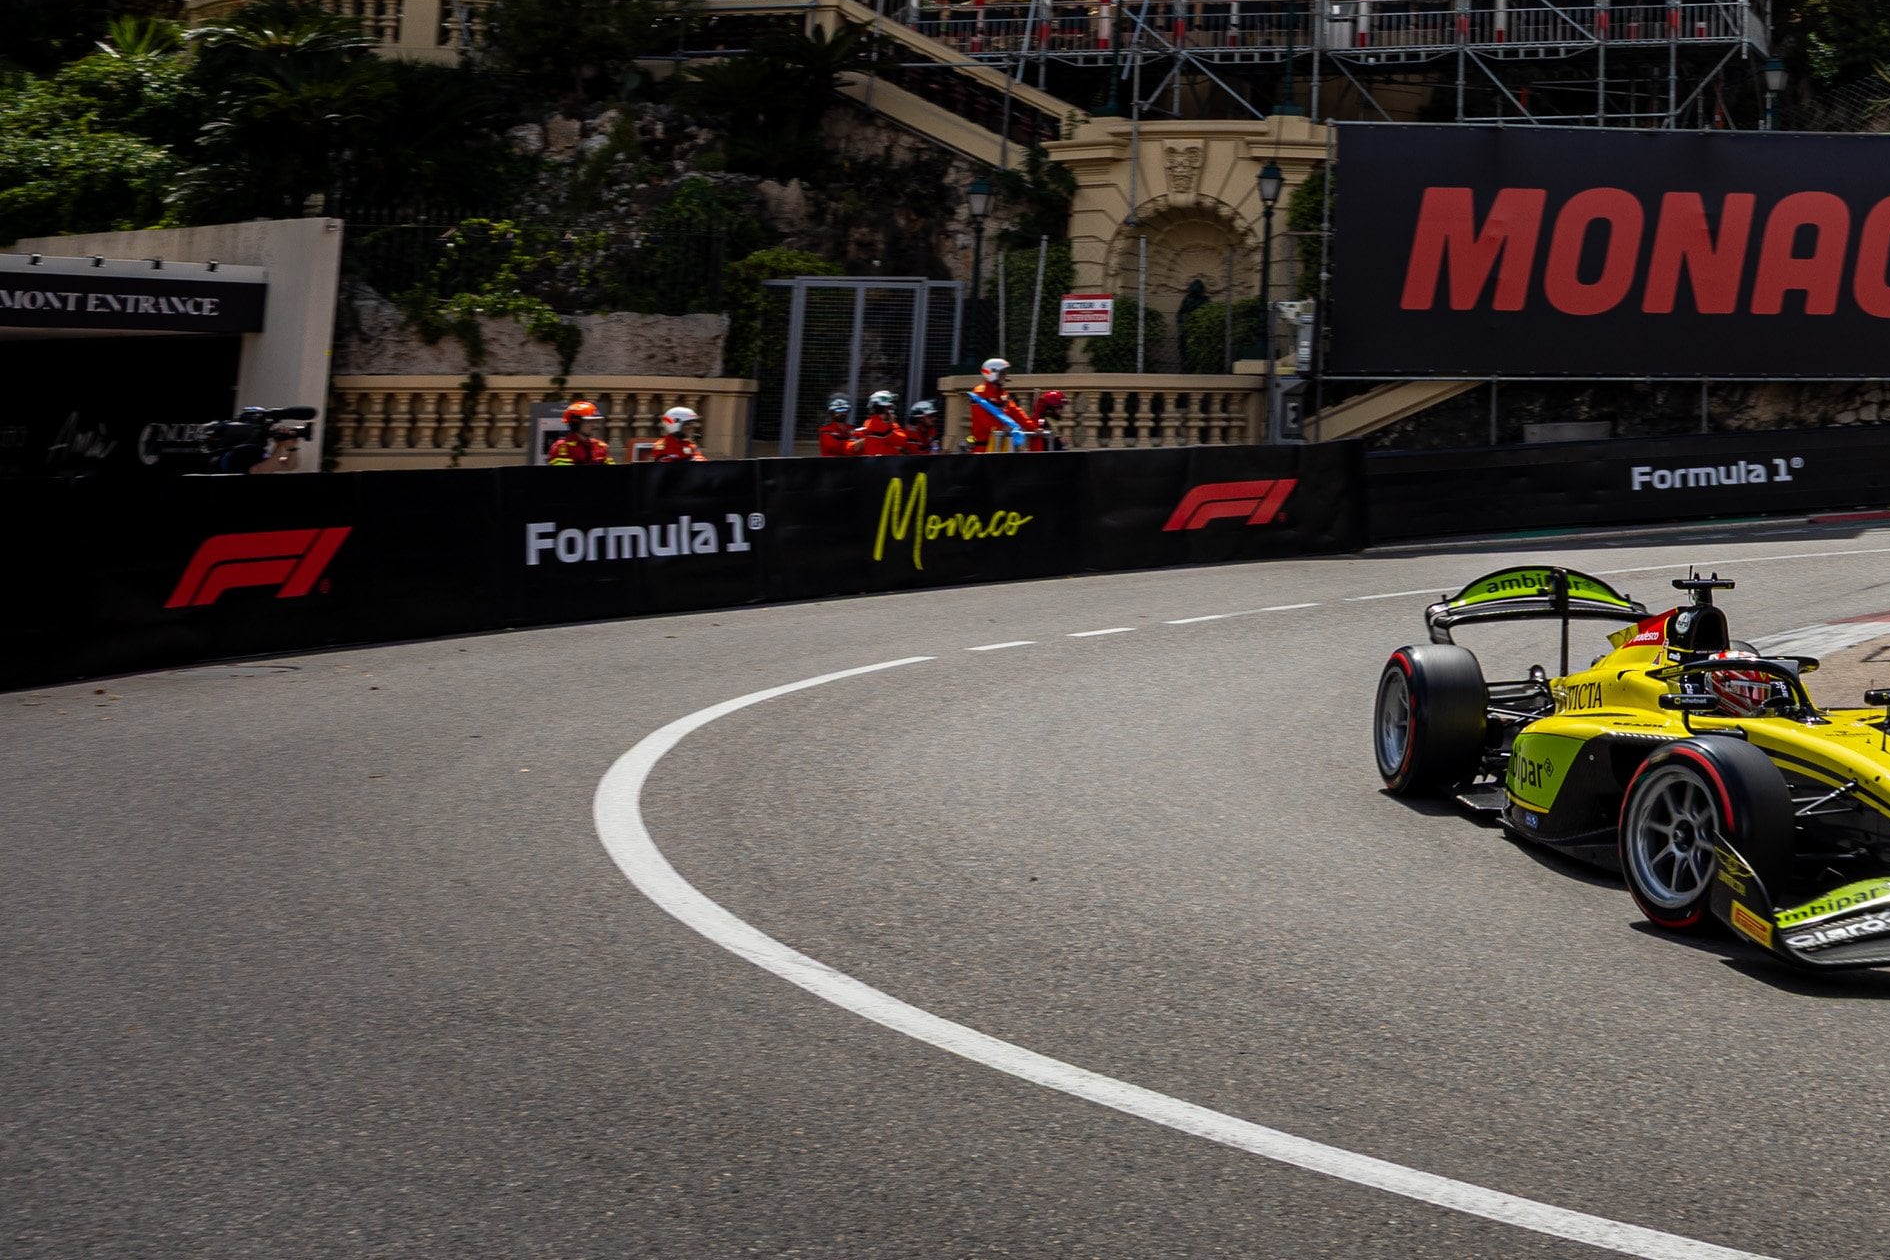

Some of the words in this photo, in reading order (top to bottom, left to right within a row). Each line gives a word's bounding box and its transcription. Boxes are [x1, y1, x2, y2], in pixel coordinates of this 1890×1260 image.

[86, 293, 219, 315] ENTRANCE
[1632, 460, 1768, 491] Formula
[526, 515, 719, 566] Formula
[873, 472, 1033, 570] Monaco
